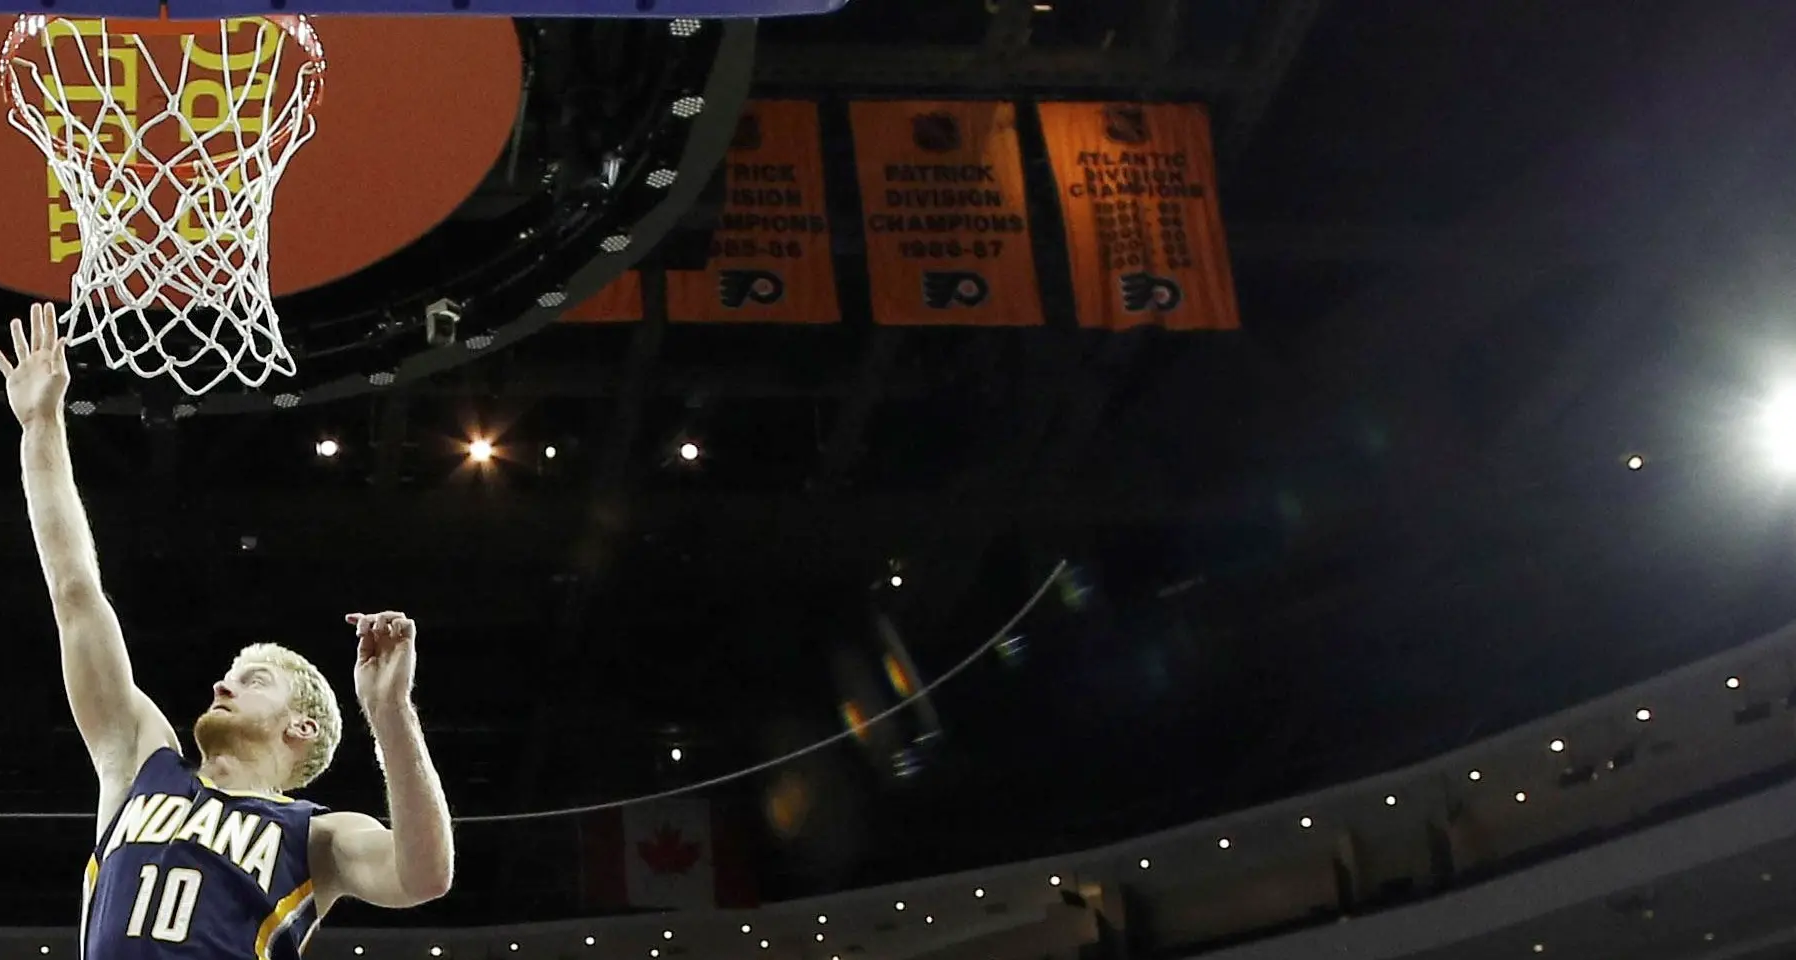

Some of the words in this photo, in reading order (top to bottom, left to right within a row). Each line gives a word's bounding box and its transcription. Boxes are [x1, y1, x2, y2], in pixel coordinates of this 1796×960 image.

[1077, 151, 1186, 166] ATLANTIC
[726, 164, 796, 182] RICK
[884, 164, 995, 182] PATRICK
[1084, 167, 1184, 182] DIVISION
[886, 189, 1002, 207] DIVISION
[1070, 183, 1203, 198] CHAMPIONS
[868, 213, 1024, 233] CHAMPIONS
[127, 865, 202, 942] 10
